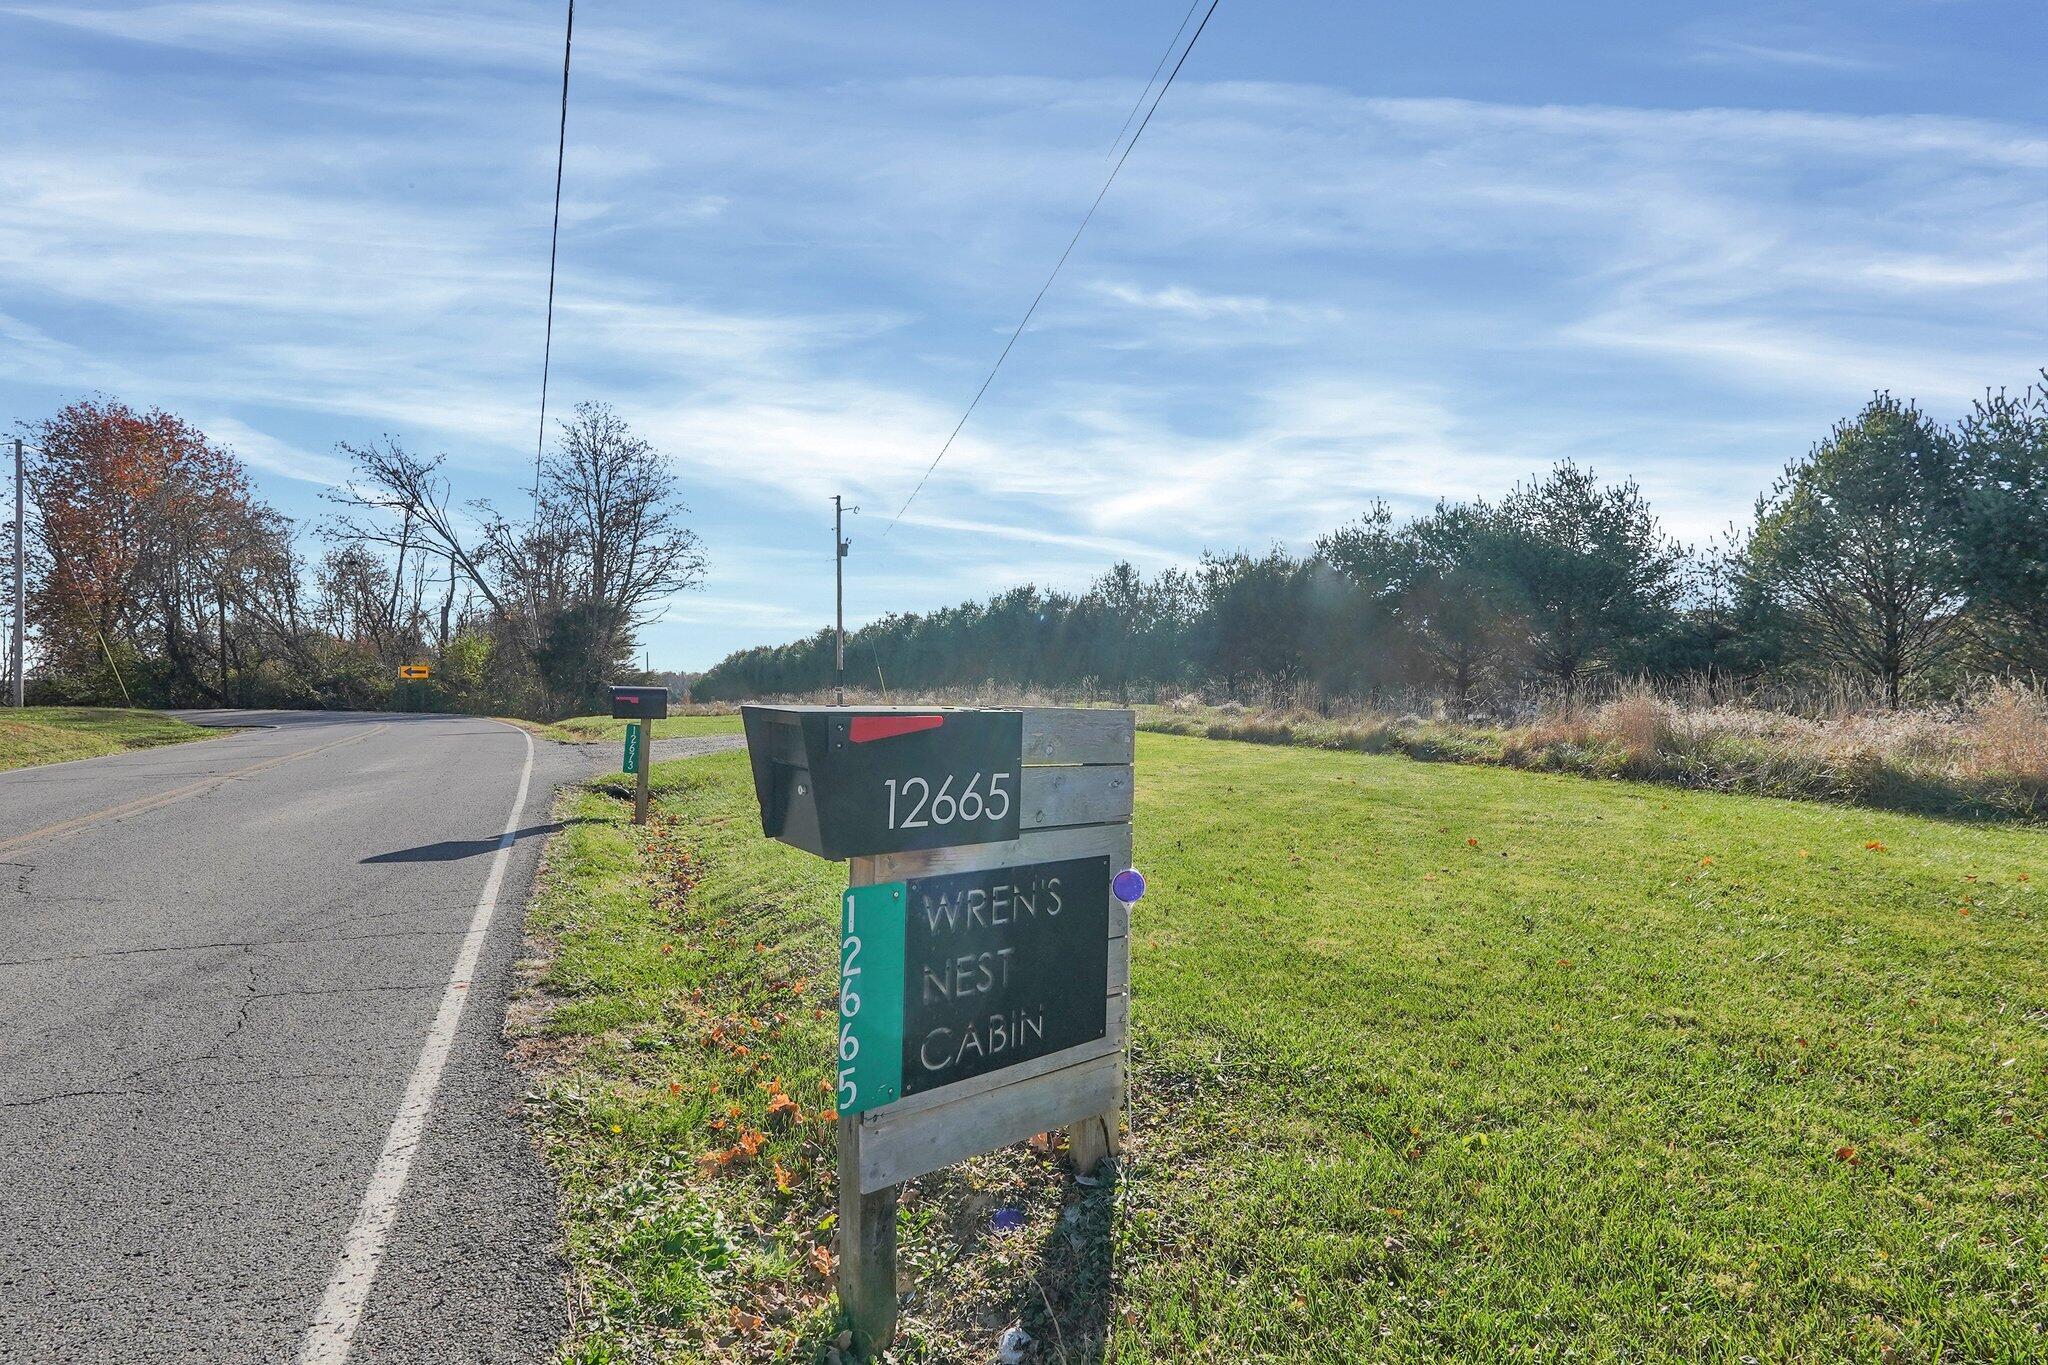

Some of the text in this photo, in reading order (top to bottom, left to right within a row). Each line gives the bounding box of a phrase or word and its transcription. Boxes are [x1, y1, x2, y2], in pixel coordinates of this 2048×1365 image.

[627, 725, 637, 770] 12673
[884, 772, 1010, 830] 12665
[923, 877, 1062, 934] WREN'S
[839, 894, 862, 1110] 12665
[922, 948, 1014, 1004] NEST
[920, 1005, 1044, 1072] CABIN
